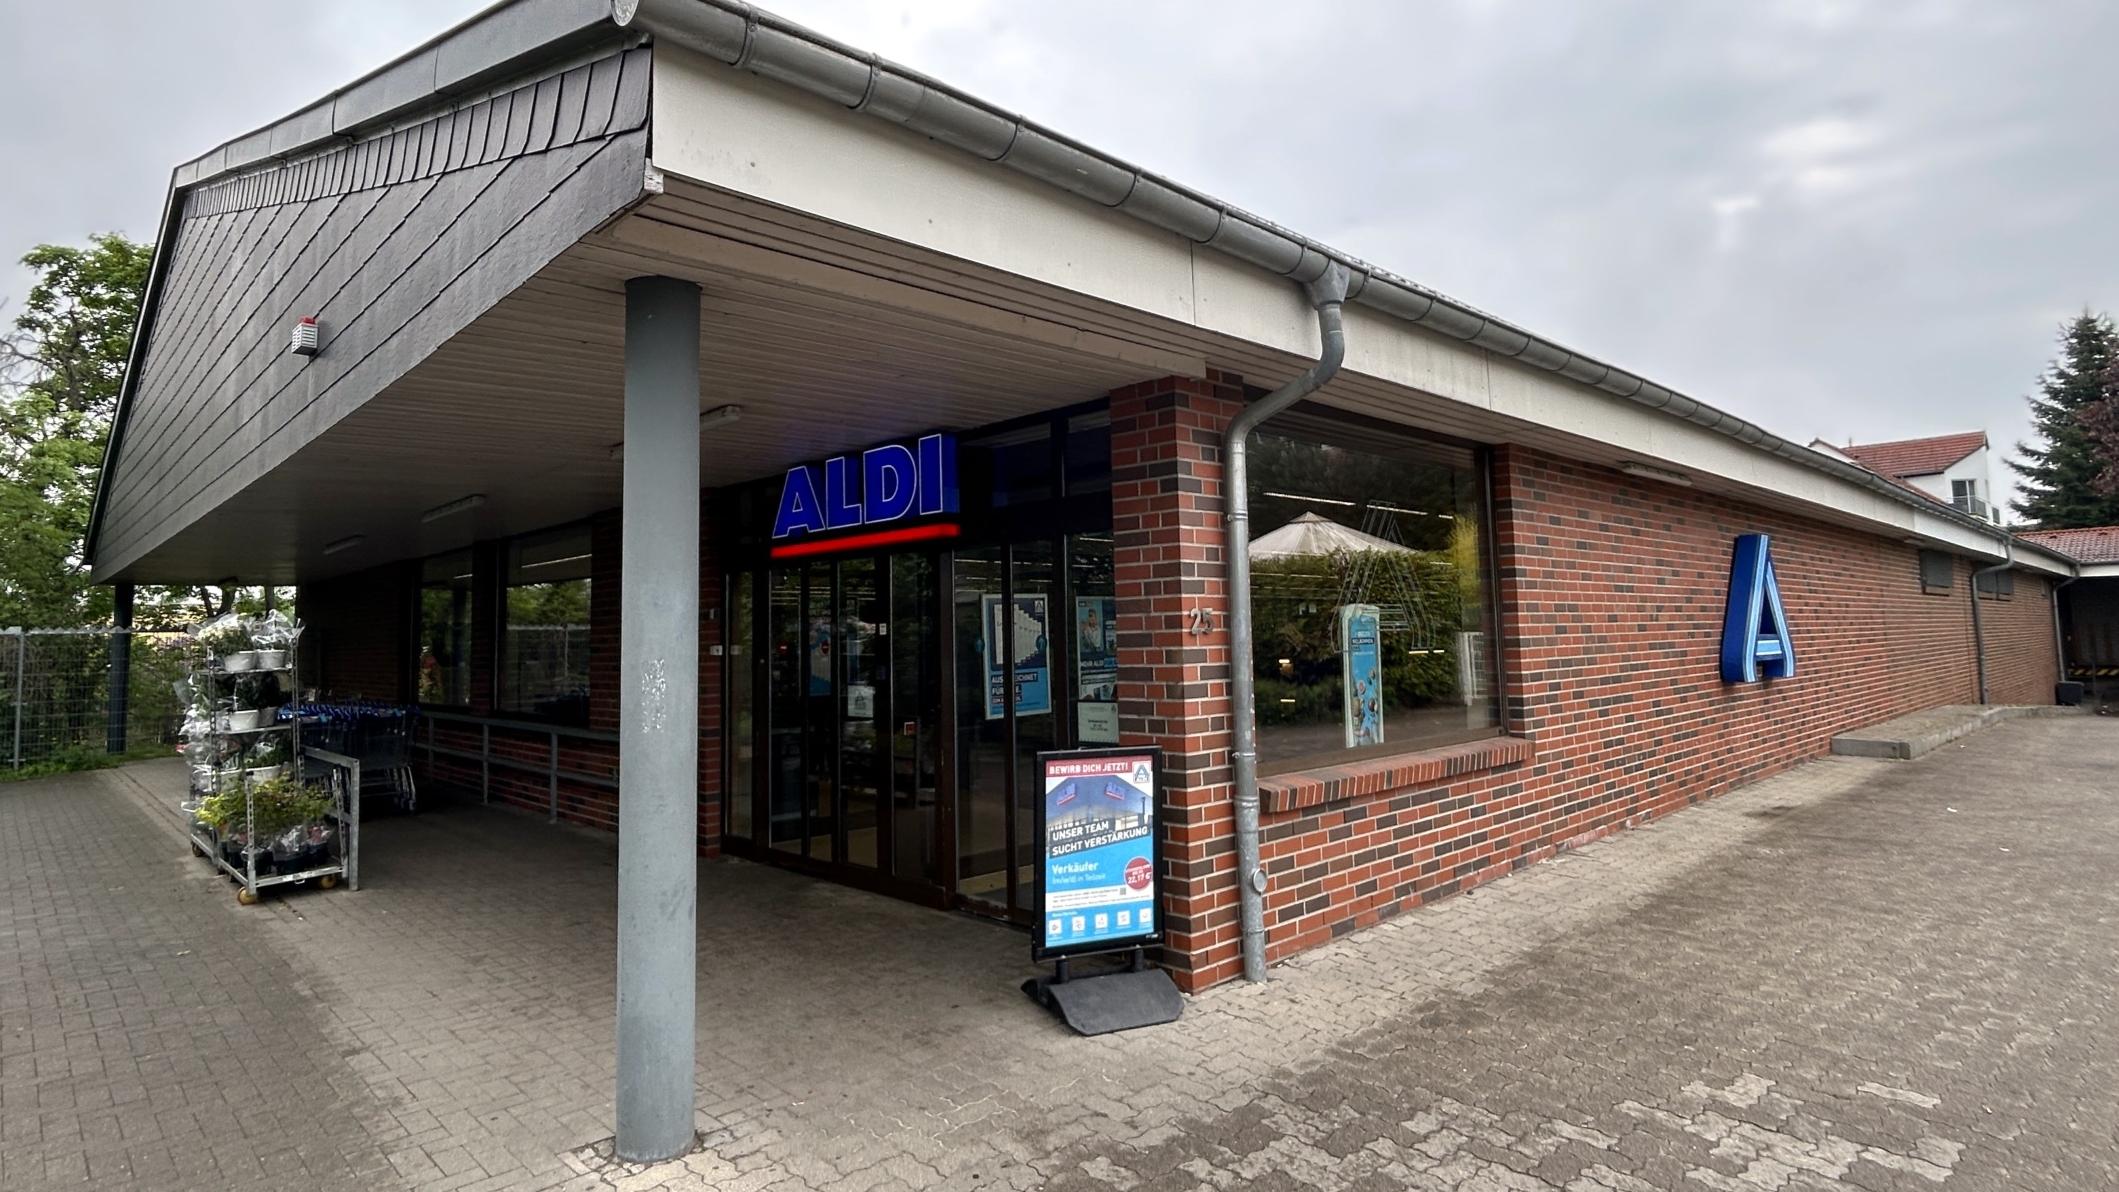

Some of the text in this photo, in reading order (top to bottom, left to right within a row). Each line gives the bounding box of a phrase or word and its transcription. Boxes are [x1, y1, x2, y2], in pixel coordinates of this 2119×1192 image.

[772, 433, 950, 539] ALDI
[1190, 607, 1215, 635] 25
[1049, 762, 1129, 774] BEWIRB DICH JETZT!
[1052, 826, 1148, 856] SUCHT VERSTÄRKUNG
[1053, 821, 1109, 841] UNSER TEAM
[1052, 861, 1099, 875] Verkäufer
